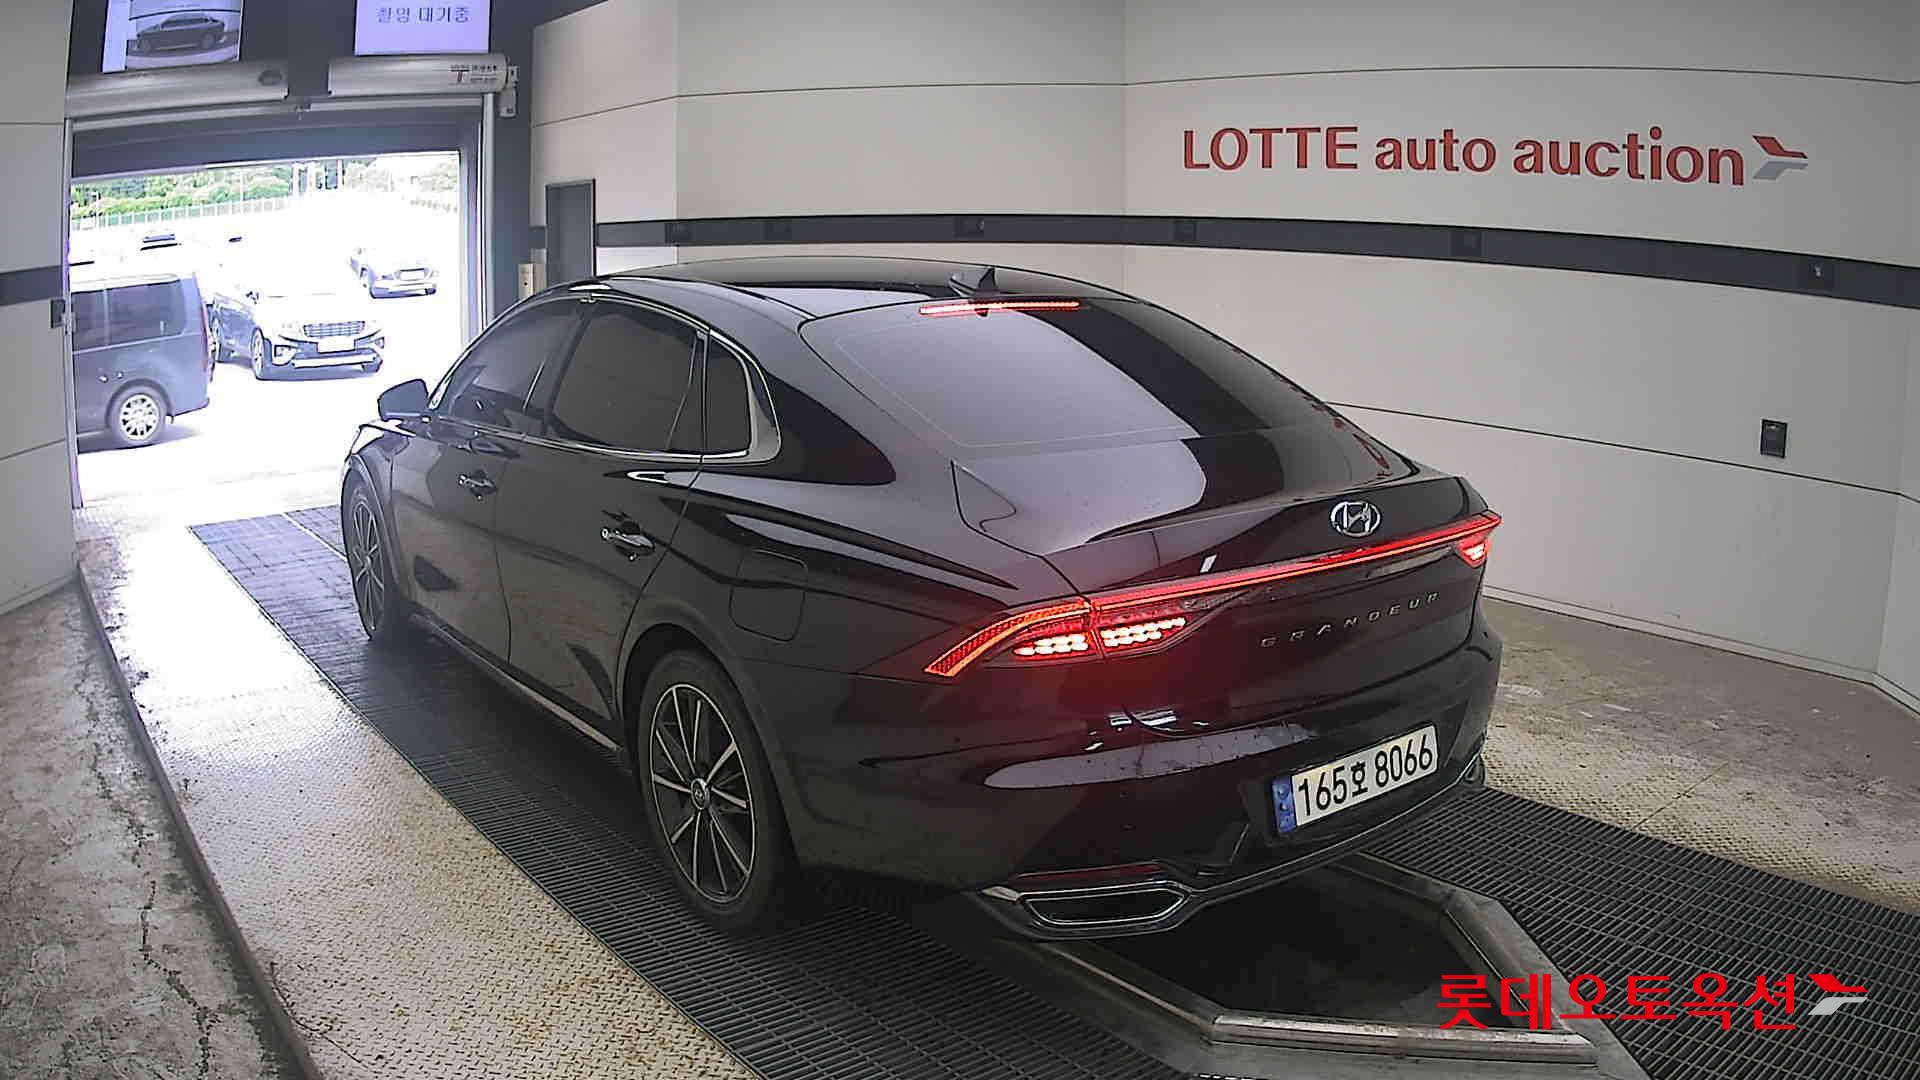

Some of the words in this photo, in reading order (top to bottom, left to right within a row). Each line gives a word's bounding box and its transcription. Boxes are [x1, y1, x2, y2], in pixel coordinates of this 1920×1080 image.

[418, 6, 469, 23] 대기중
[1183, 126, 1358, 171] LOTTE
[1375, 128, 1497, 173] auto
[1512, 126, 1745, 187] auction
[1260, 592, 1439, 648] GRANDEUR
[1297, 761, 1370, 817] 165호
[1374, 733, 1434, 789] 8066
